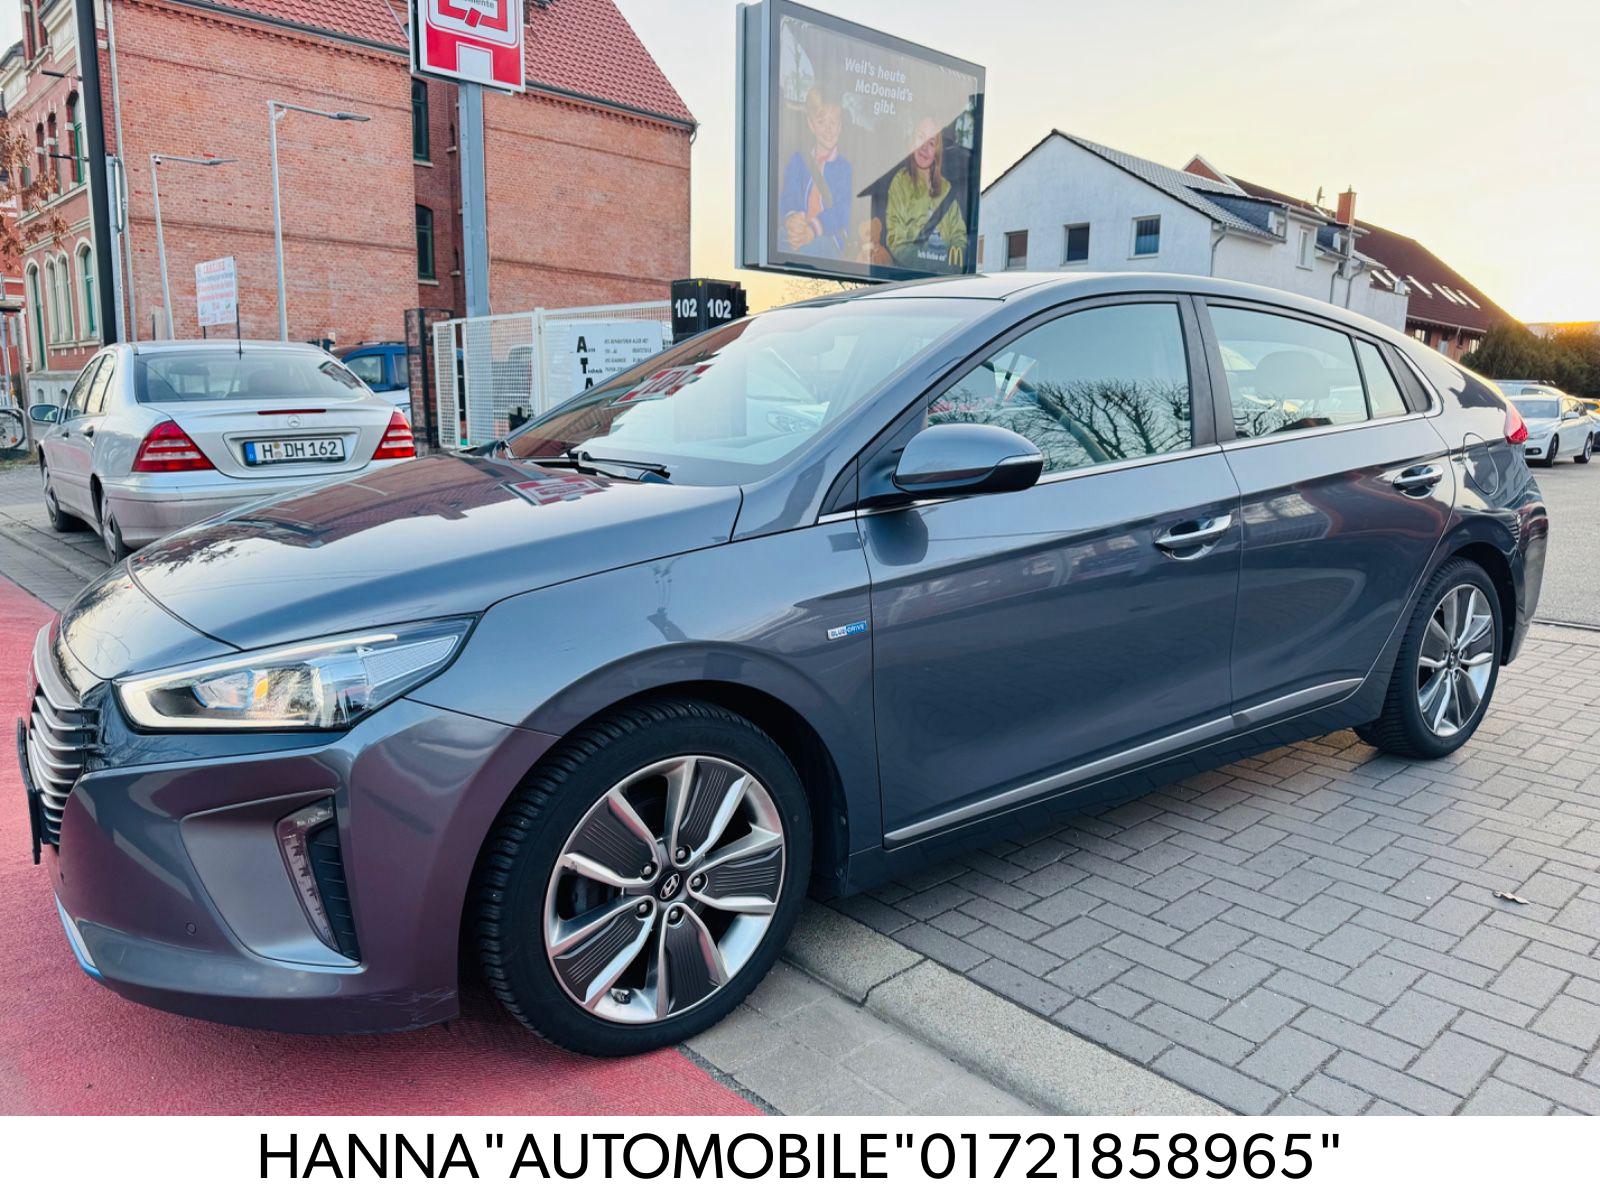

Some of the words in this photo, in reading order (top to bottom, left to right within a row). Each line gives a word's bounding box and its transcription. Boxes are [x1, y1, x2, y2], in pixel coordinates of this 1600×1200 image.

[845, 57, 875, 76] Weil's
[878, 66, 906, 83] heute
[855, 79, 913, 102] McDonald's
[675, 298, 698, 318] 102
[707, 298, 732, 319] 102
[262, 444, 273, 458] H
[284, 442, 306, 457] DH
[308, 441, 338, 457] 162
